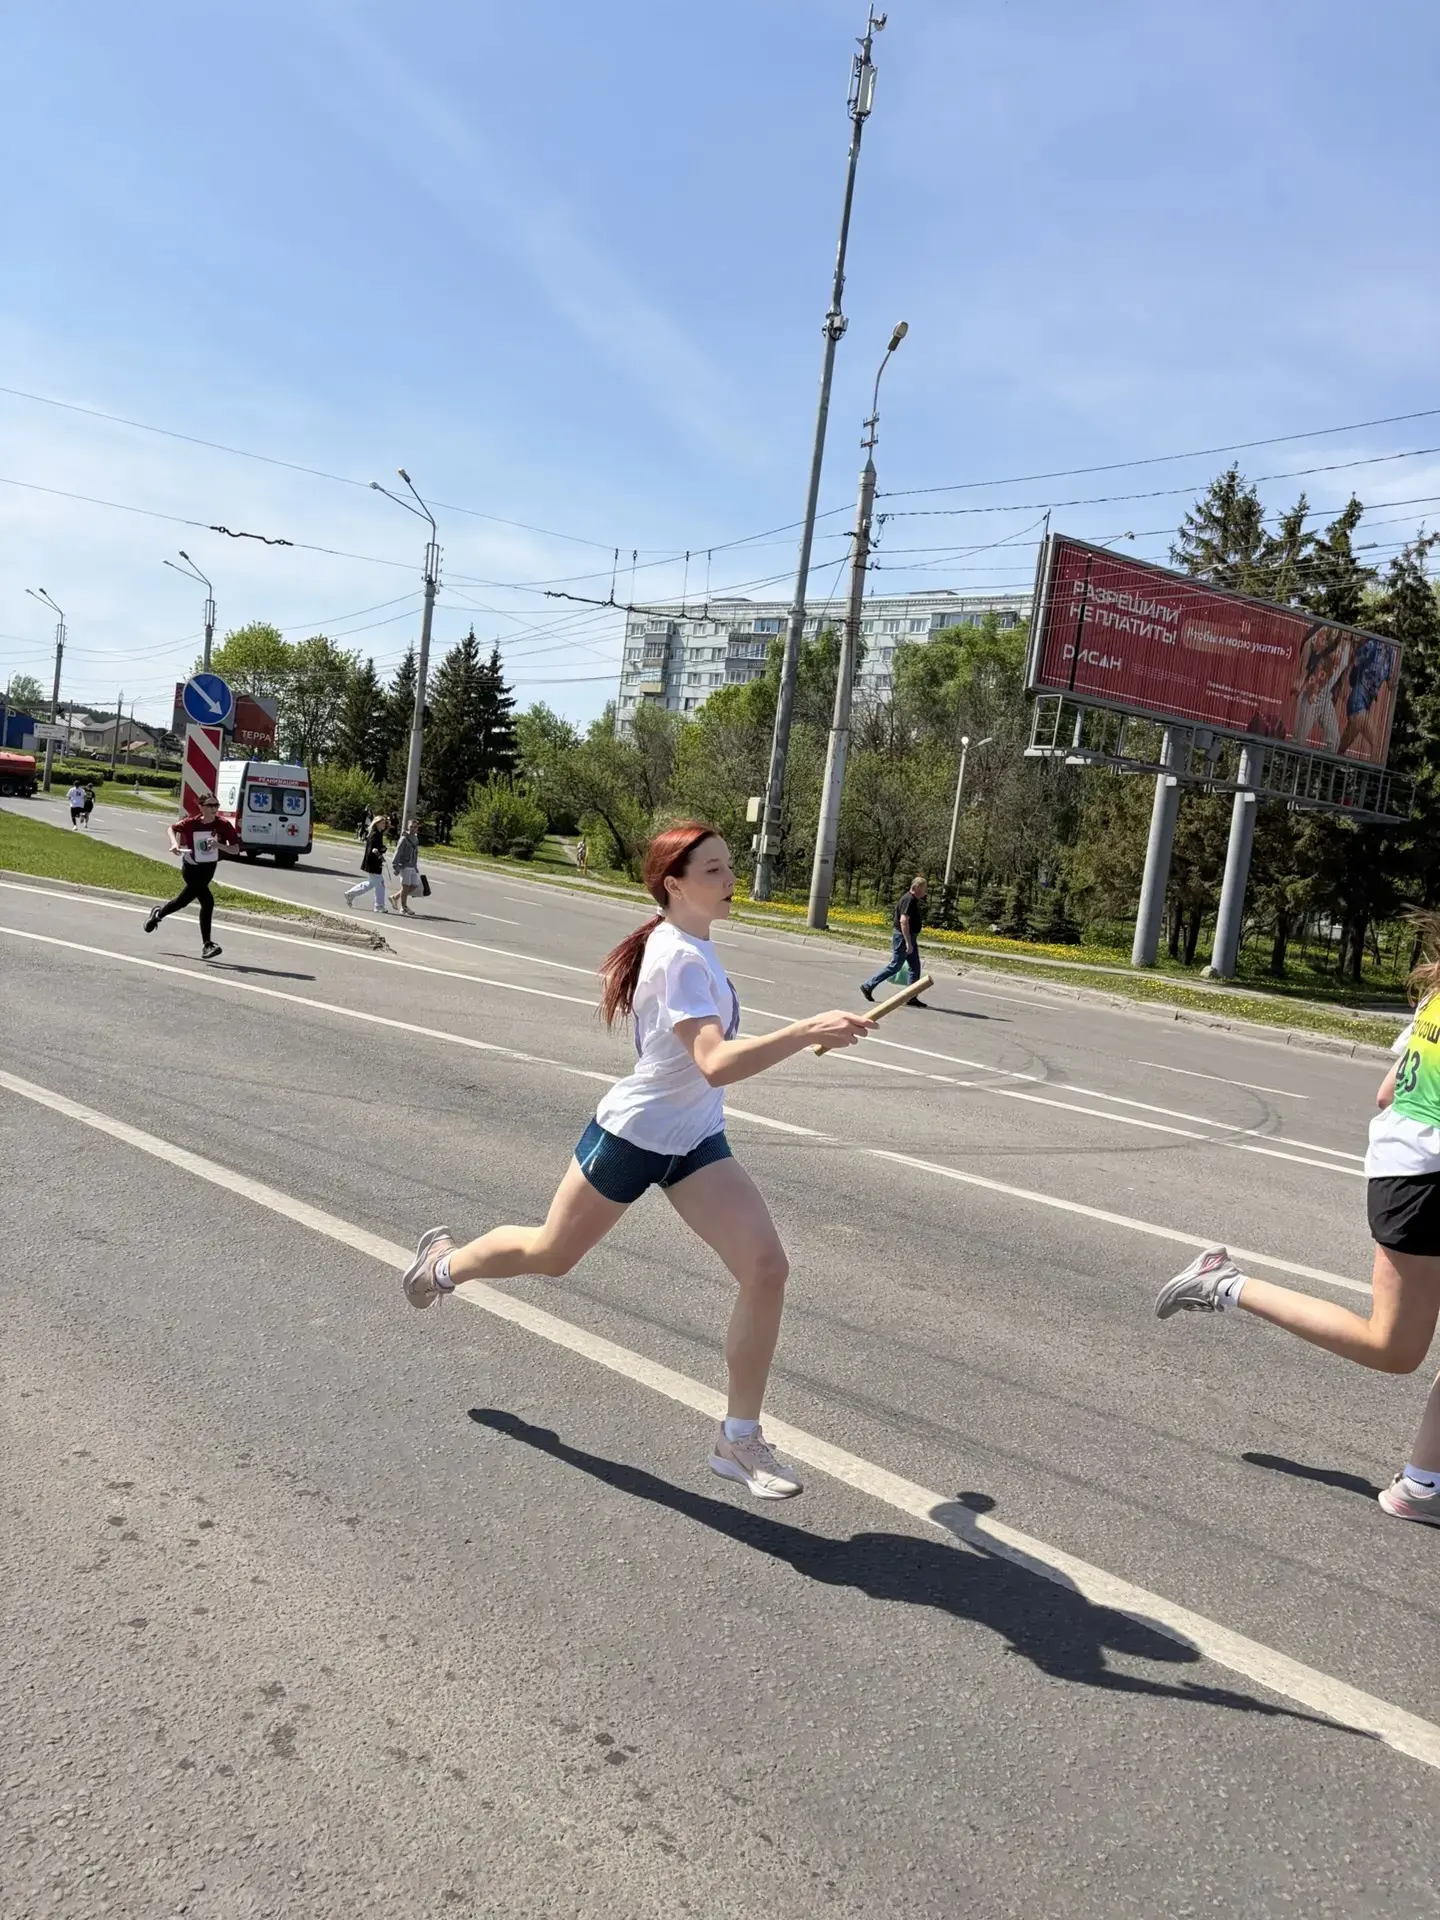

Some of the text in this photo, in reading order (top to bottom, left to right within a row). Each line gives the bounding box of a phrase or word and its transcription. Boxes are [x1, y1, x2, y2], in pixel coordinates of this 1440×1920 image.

[1069, 601, 1177, 645] НЕ ПЛАТИТЬ!
[1073, 580, 1180, 625] РАЗРЕШИЛИ
[241, 729, 272, 743] ТЕРРА
[1396, 1048, 1421, 1093] 43
